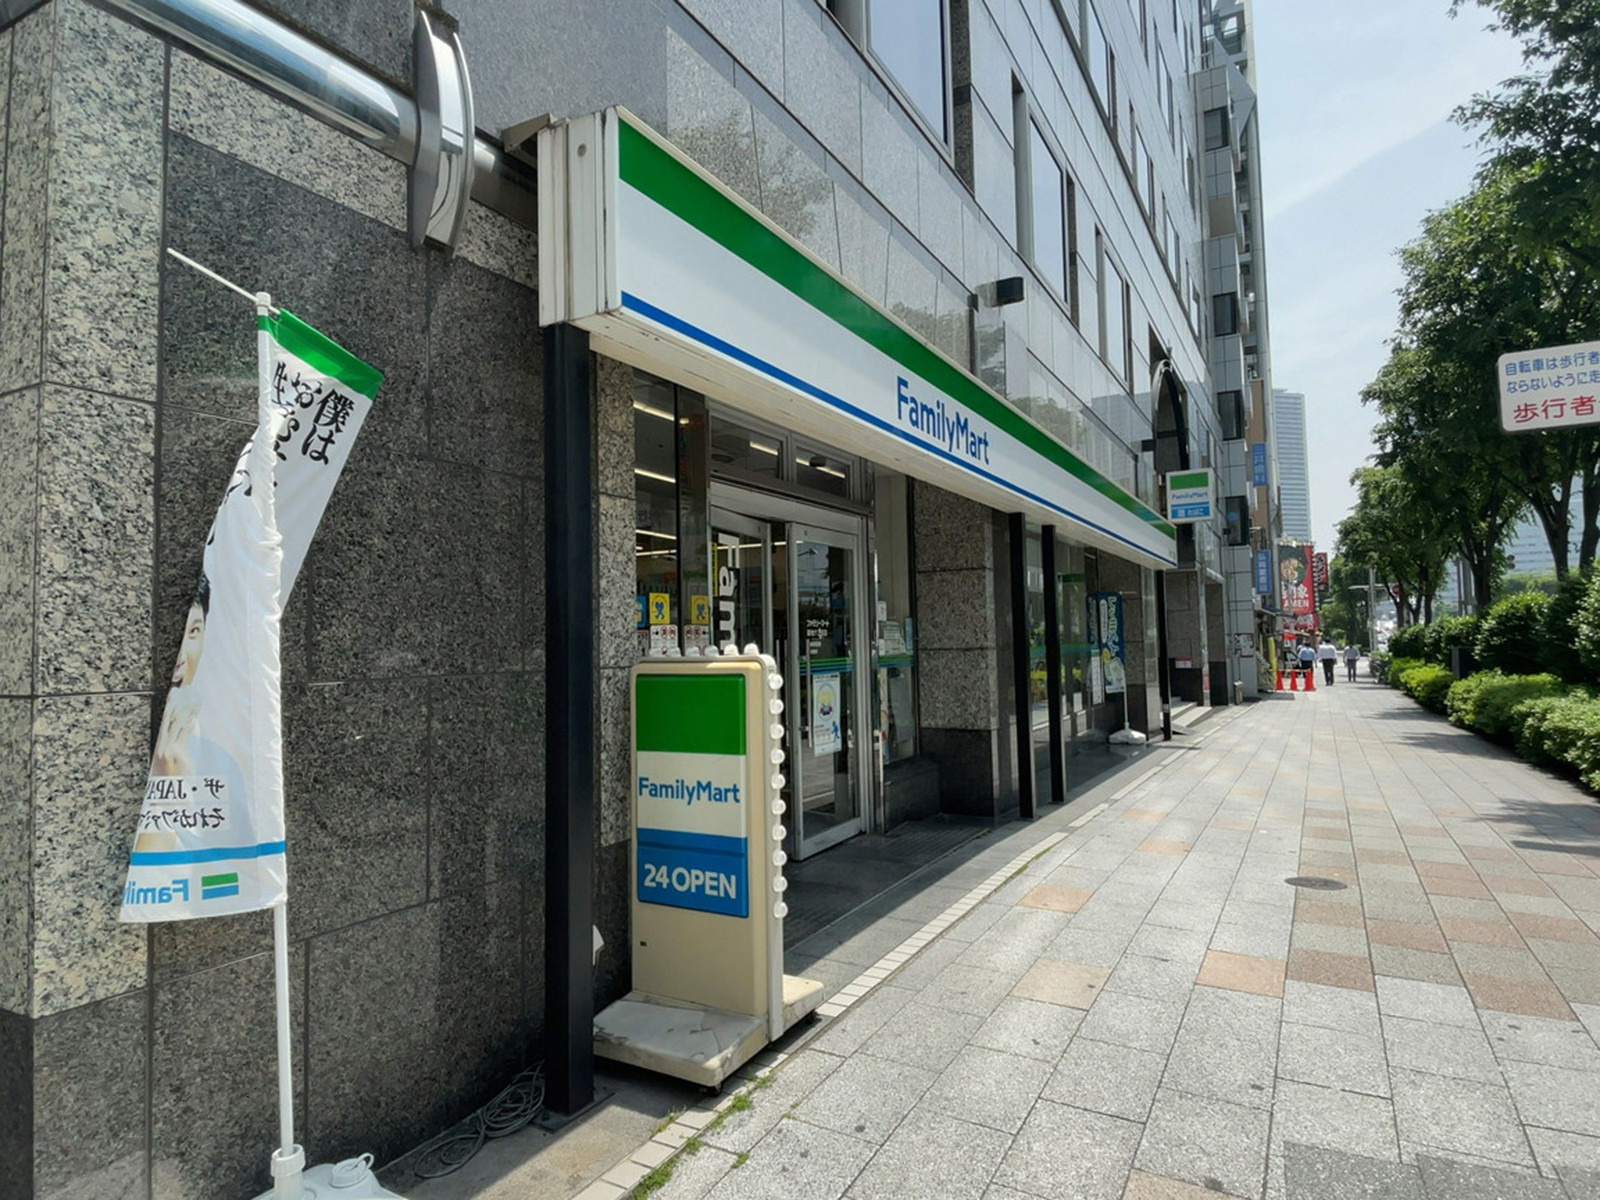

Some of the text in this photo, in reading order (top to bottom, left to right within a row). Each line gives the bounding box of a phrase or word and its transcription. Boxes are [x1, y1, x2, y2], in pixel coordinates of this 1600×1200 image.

[1505, 351, 1600, 376] 自転車は歩行者
[897, 375, 989, 465] FamilyMart
[1513, 395, 1596, 423] 歩行者
[302, 388, 354, 465] 僕は
[1171, 491, 1208, 500] FamilyMart
[638, 776, 741, 806] FamilyMart
